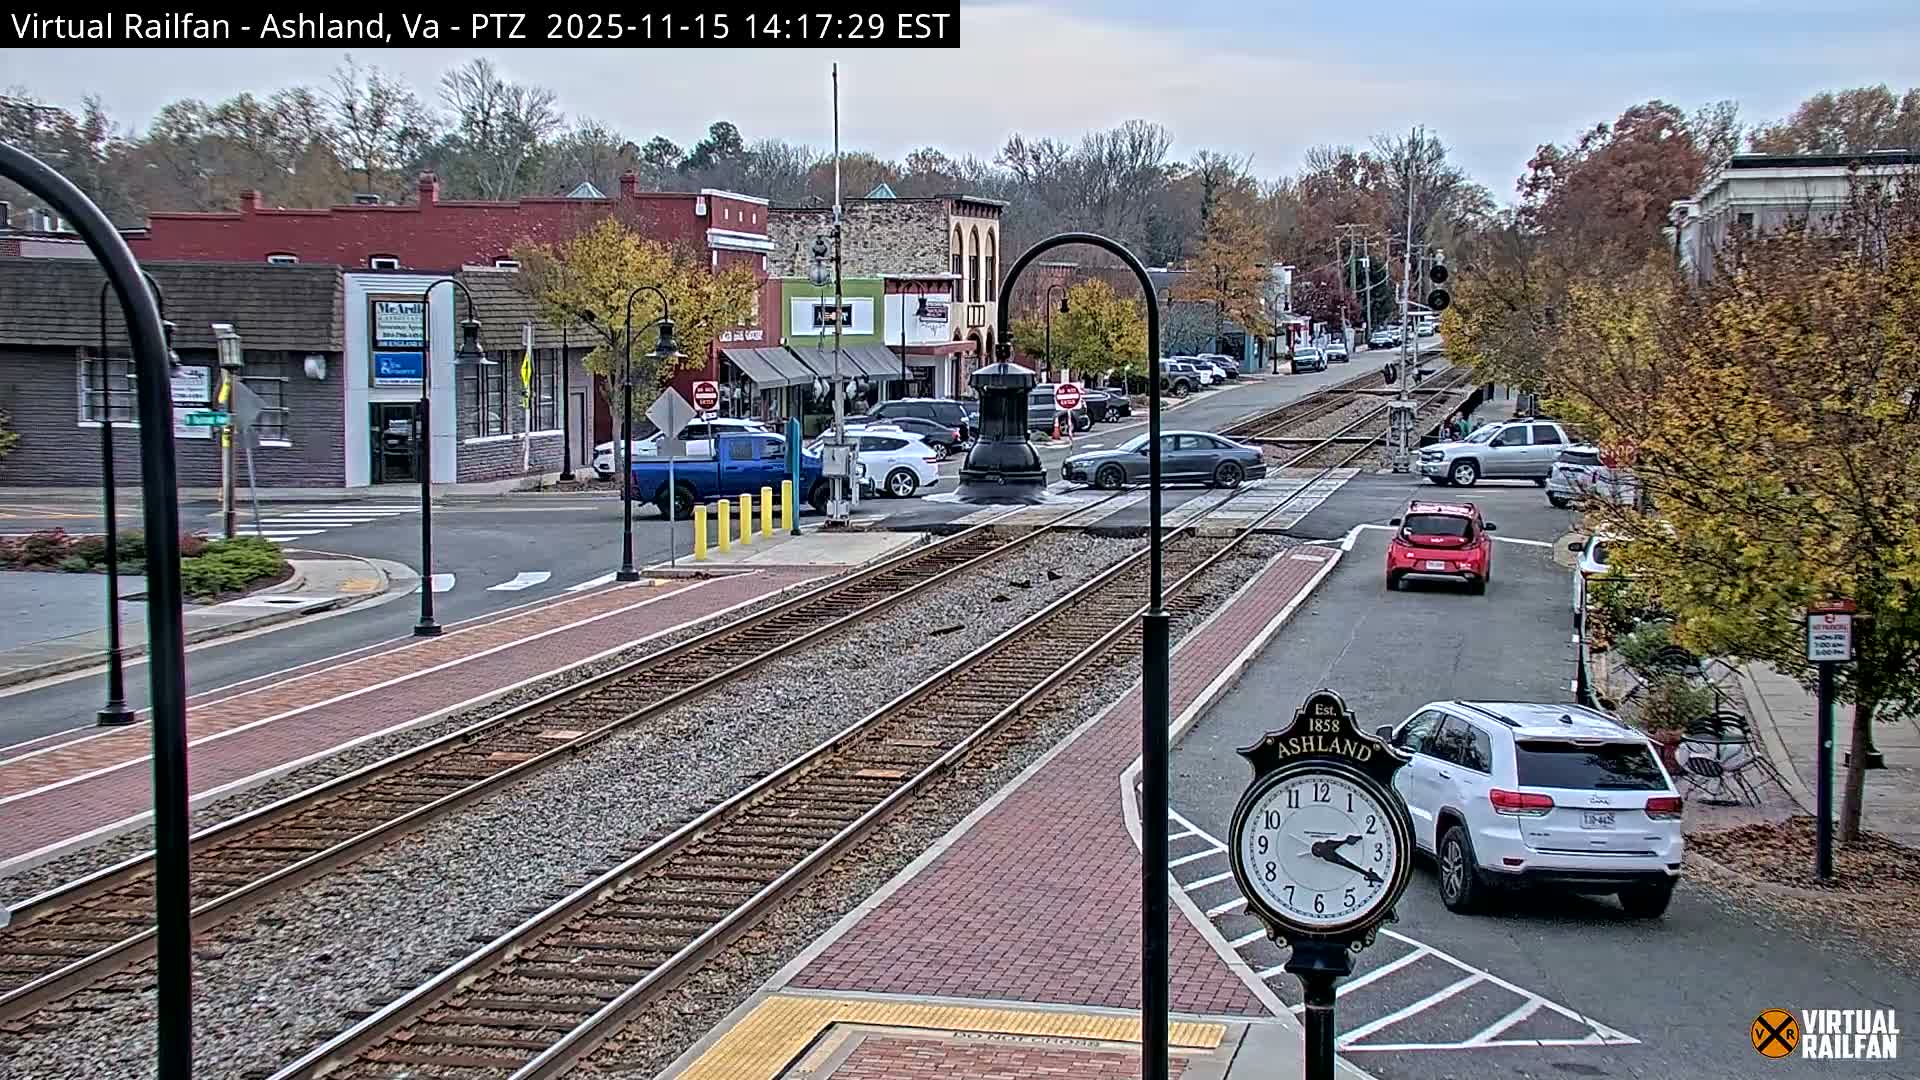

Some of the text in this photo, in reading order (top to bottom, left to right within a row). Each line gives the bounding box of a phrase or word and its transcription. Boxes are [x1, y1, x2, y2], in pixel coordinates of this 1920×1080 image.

[1315, 703, 1337, 716] Est.
[1309, 718, 1340, 733] 1858
[1278, 735, 1372, 762] ASHLAND
[1287, 789, 1299, 809] 11
[1313, 783, 1331, 803] 12
[1346, 793, 1353, 813] 1
[1264, 810, 1280, 830] 10
[1366, 814, 1377, 834] 2
[1258, 835, 1269, 855] 9
[1374, 842, 1383, 862] 3
[1265, 861, 1276, 882] 8
[1283, 885, 1295, 906] 7
[1313, 893, 1325, 913] 6
[1344, 888, 1356, 908] 5
[953, 1031, 982, 1039] DO
[987, 1033, 1024, 1042] NOT
